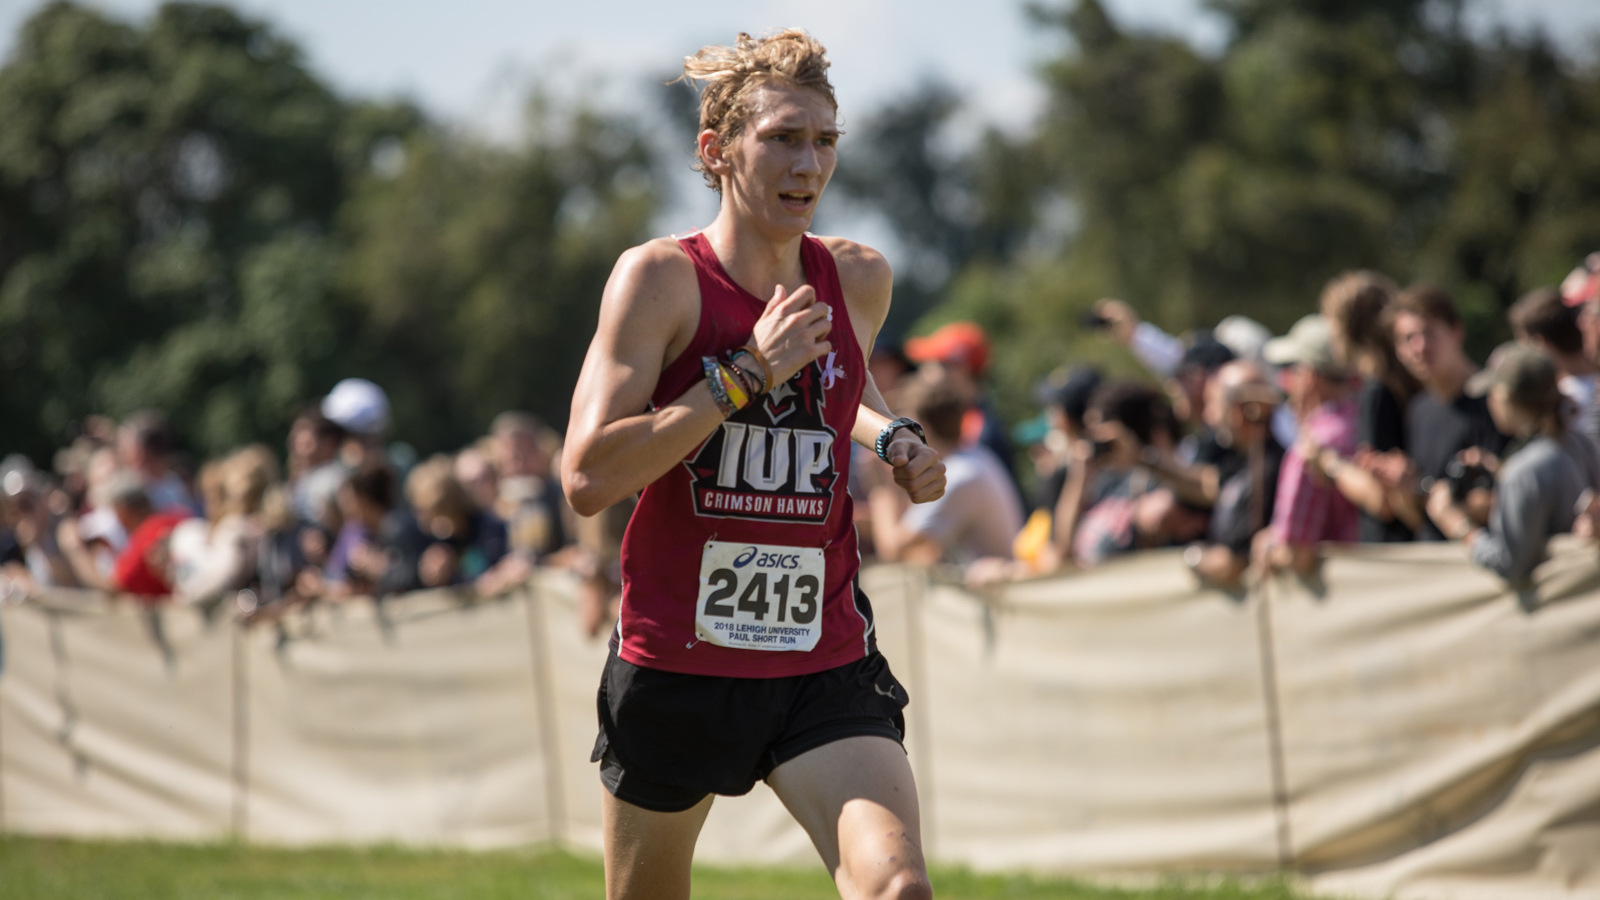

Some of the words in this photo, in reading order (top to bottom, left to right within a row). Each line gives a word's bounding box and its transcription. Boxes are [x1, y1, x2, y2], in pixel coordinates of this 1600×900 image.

[717, 421, 834, 494] IUP
[704, 491, 773, 513] CRIMSON
[777, 498, 823, 516] HAWKS
[704, 568, 819, 624] 2413
[714, 622, 735, 631] 2018
[736, 624, 766, 634] LEHIGH
[768, 627, 810, 636] UNIVERSITY
[729, 632, 750, 642] PAUL
[752, 635, 777, 644] SHORT
[779, 636, 796, 644] RUN
